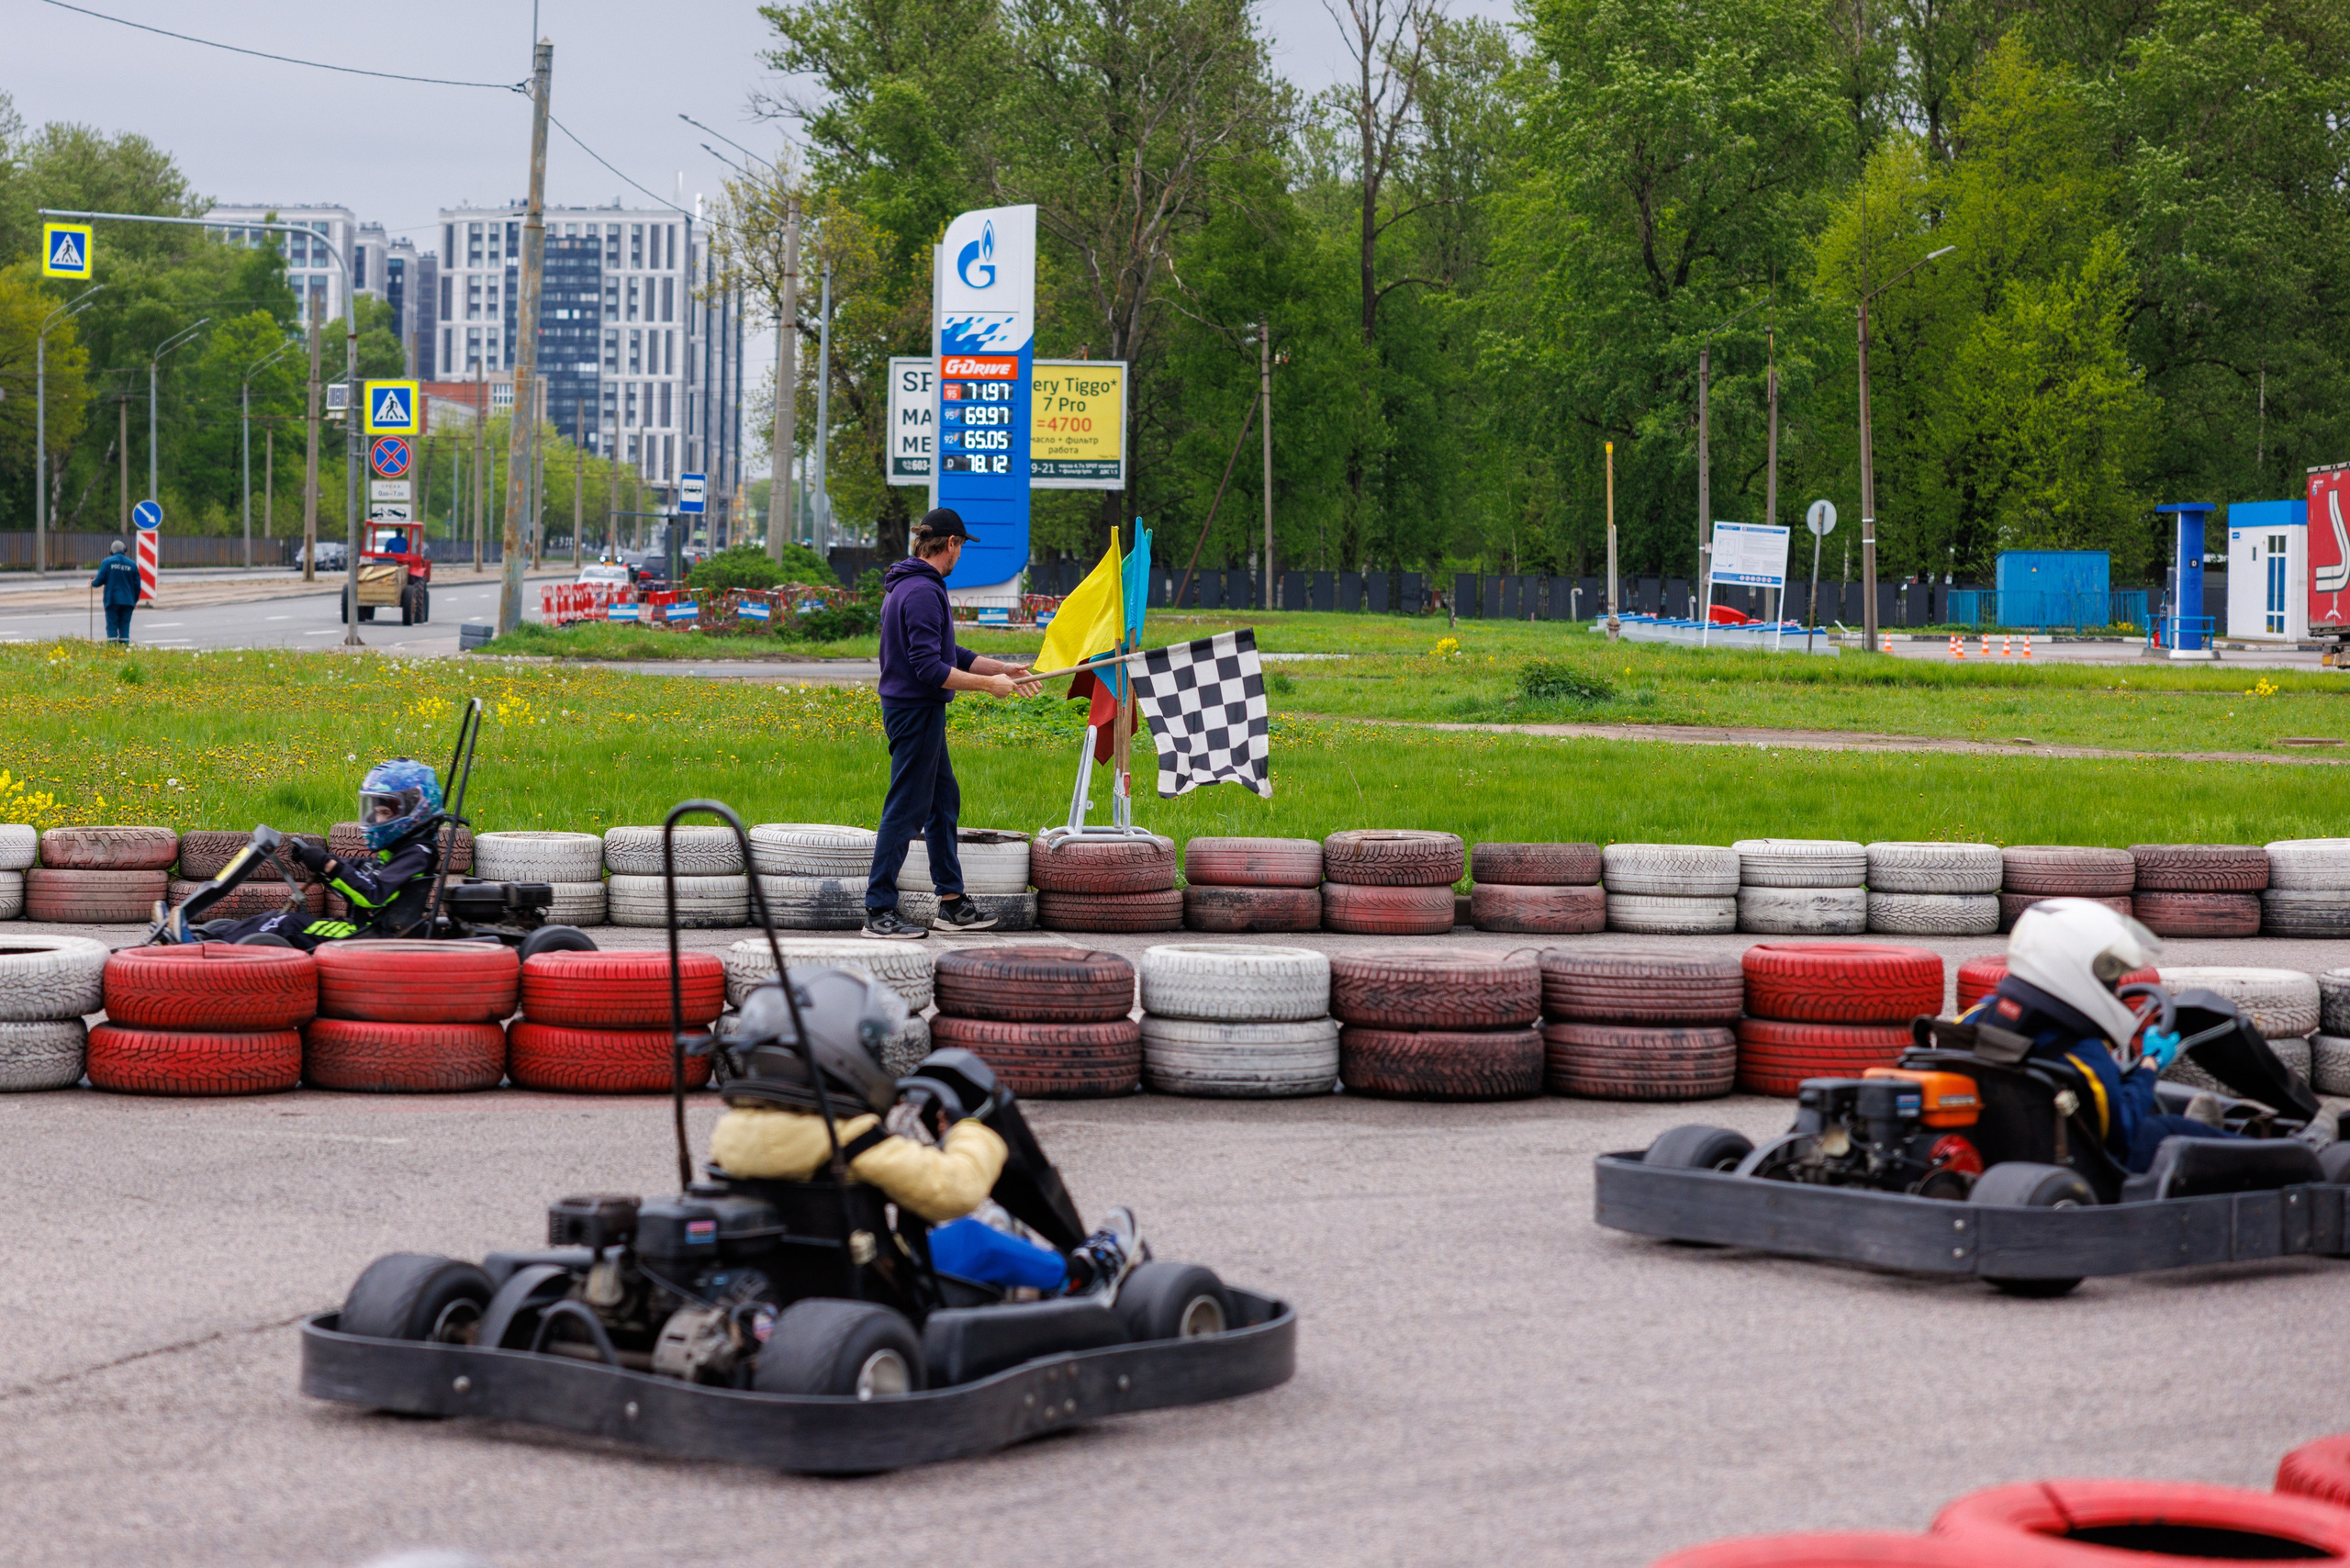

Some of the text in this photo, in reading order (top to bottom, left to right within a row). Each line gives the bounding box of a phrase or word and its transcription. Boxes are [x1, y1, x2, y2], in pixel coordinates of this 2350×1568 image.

[946, 383, 1009, 401] 95 71.97
[1043, 397, 1087, 412] 7 Pro
[945, 407, 1009, 425] 95 69.97
[1036, 417, 1092, 432] =4700
[944, 431, 1008, 449] 92 65.05
[1066, 436, 1099, 445] фильтр
[1048, 446, 1079, 454] работа
[947, 454, 1007, 473] D 78.12
